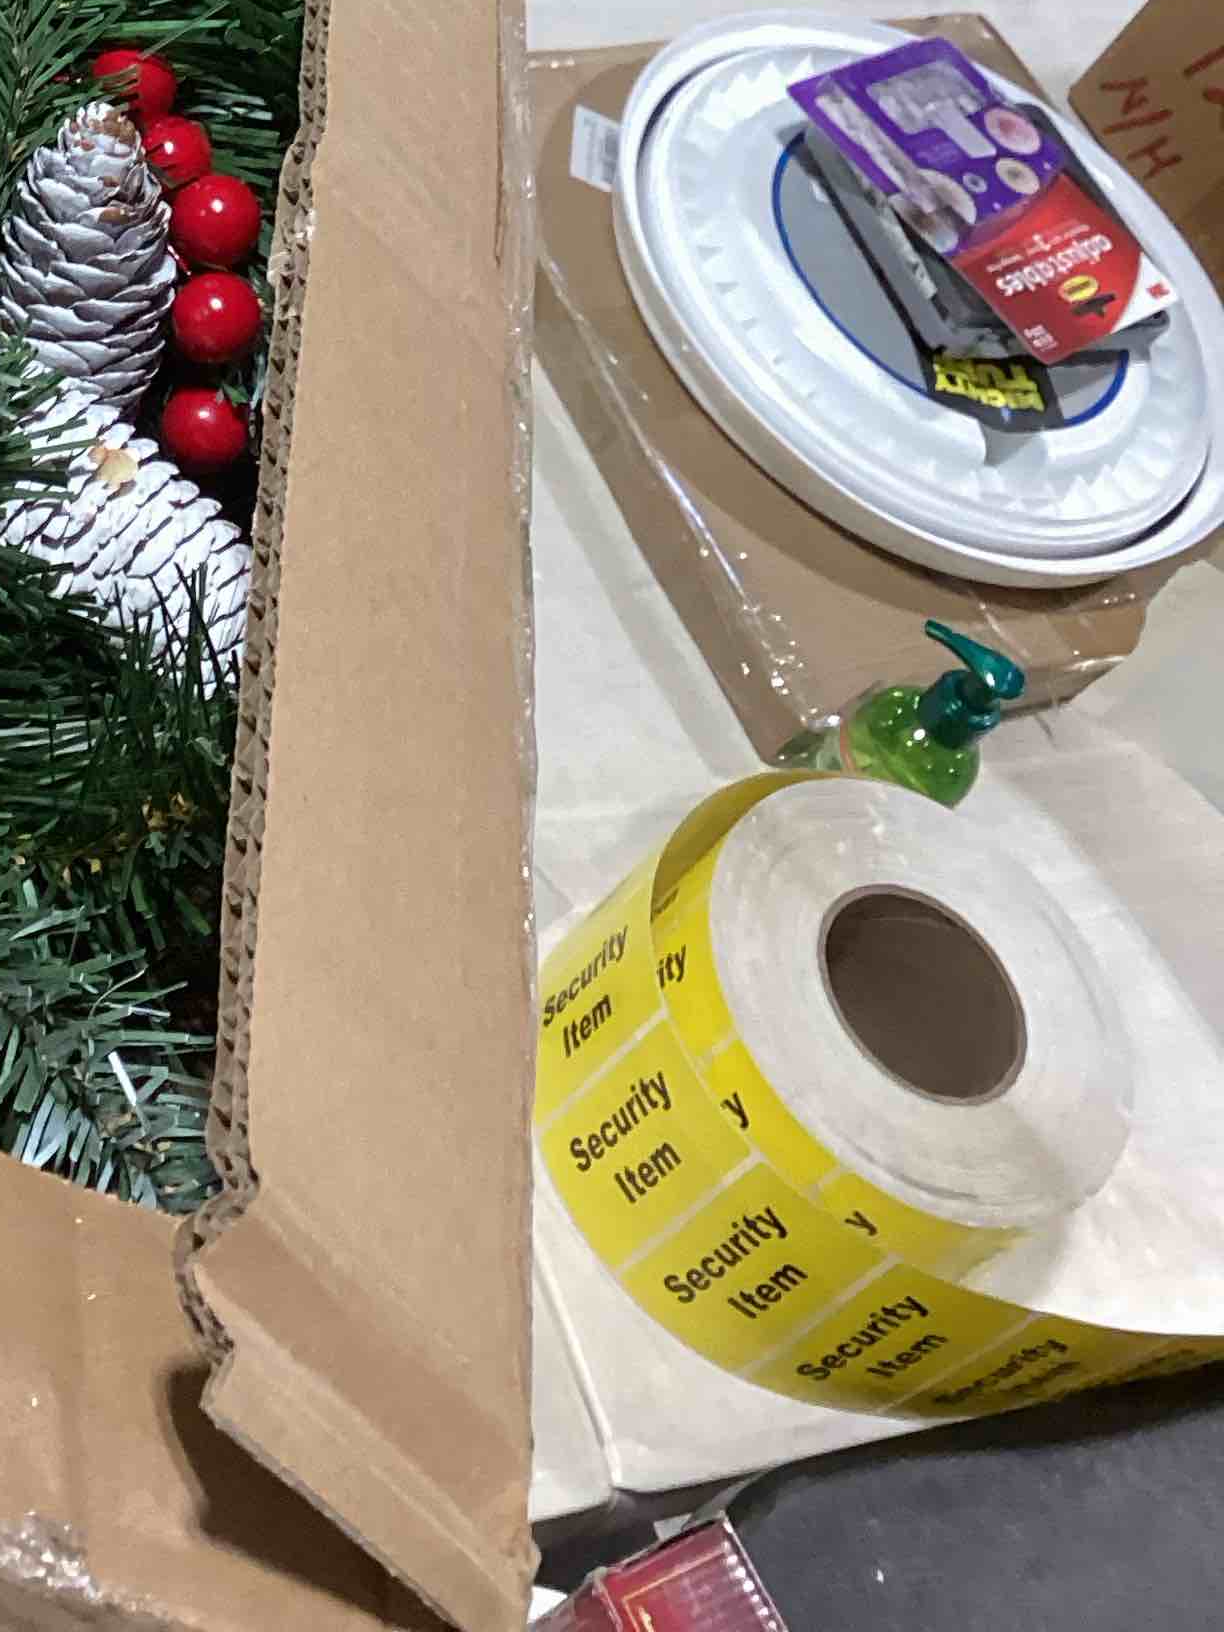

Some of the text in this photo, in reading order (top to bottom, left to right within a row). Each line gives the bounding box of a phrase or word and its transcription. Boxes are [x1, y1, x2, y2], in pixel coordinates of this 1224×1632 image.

[542, 924, 629, 1028] Security
[656, 943, 687, 990] ity
[561, 994, 613, 1058] Item
[569, 1070, 672, 1173] Security
[613, 1141, 682, 1204] Item
[663, 1205, 789, 1304] Security
[727, 1263, 809, 1319] Item
[796, 1294, 929, 1382] Security
[866, 1331, 950, 1379] Item
